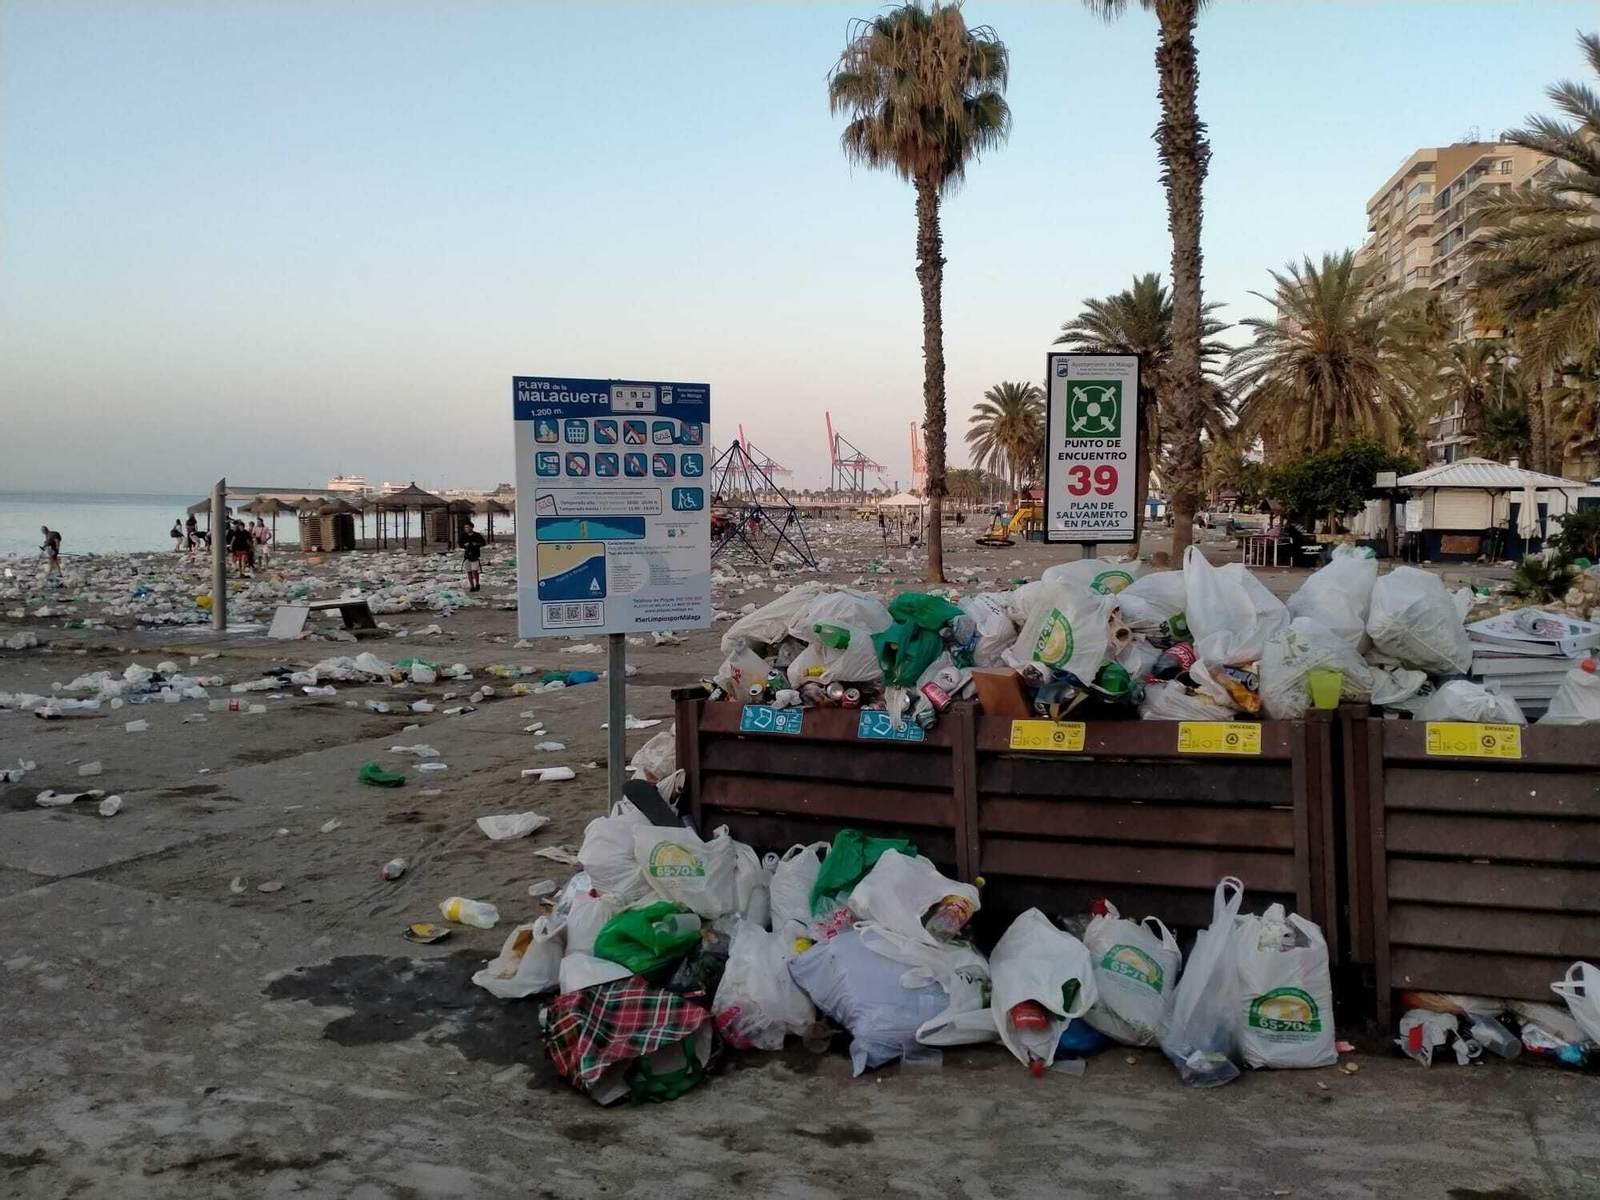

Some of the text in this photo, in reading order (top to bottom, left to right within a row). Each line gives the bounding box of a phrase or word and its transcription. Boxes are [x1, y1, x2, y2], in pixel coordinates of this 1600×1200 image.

[531, 408, 552, 417] 1.200
[1064, 440, 1121, 448] PUNTO DE
[1058, 452, 1127, 460] ENCUENTRO
[1067, 465, 1119, 496] 39
[1070, 502, 1114, 510] PLAN DE
[1056, 511, 1128, 519] SALVAMENTO
[1064, 519, 1120, 528] EN PLAYAS
